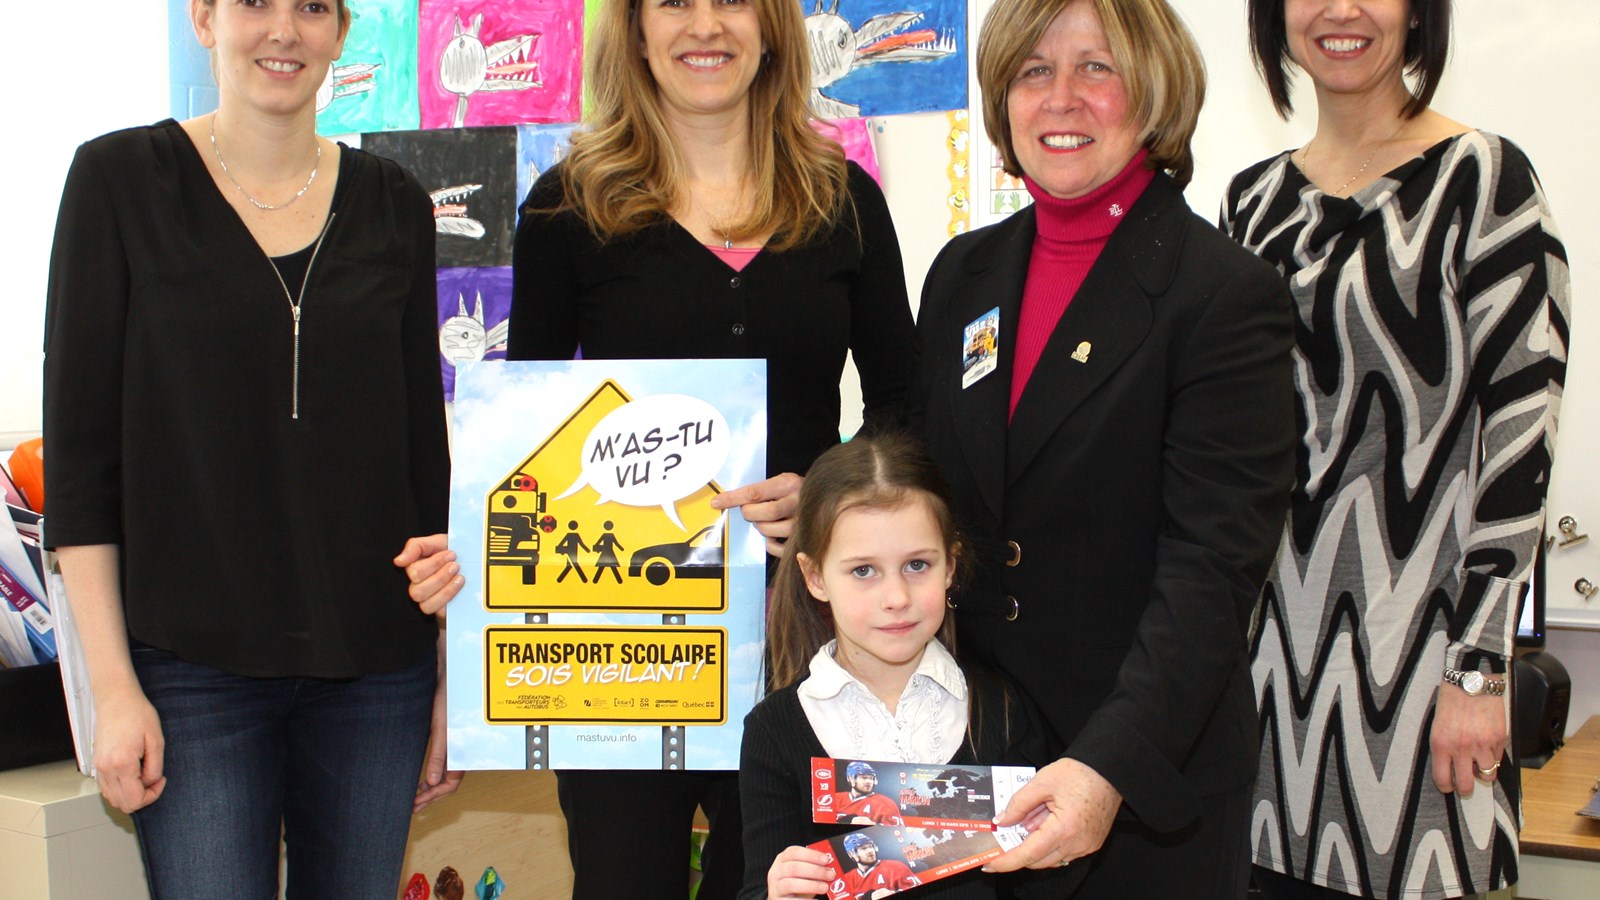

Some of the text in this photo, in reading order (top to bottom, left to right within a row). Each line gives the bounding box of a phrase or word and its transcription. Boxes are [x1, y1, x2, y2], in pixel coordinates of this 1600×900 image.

[590, 419, 714, 464] M'AS-TU
[616, 453, 682, 488] VU ?
[496, 643, 716, 665] TRANSPORT SCOLAIRE
[505, 664, 573, 687] SOIS
[576, 732, 637, 743] mastuvu.info
